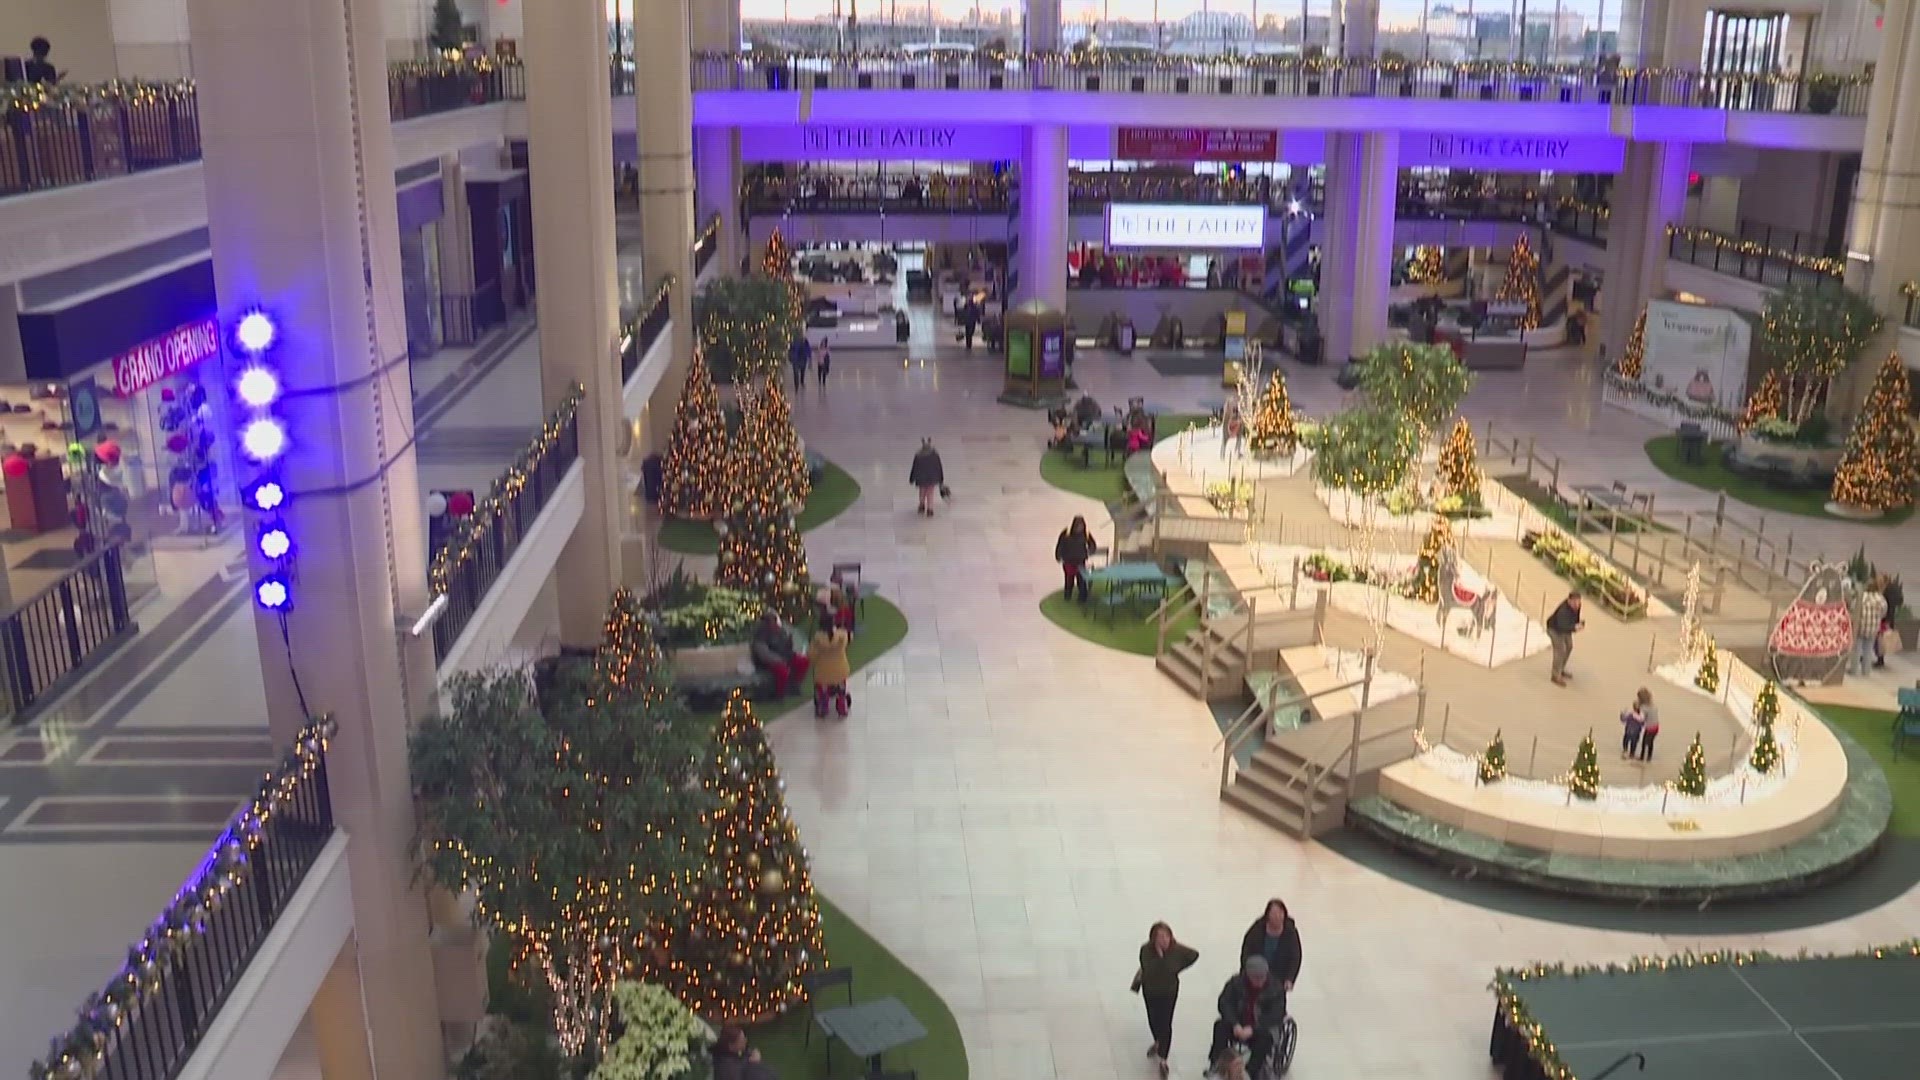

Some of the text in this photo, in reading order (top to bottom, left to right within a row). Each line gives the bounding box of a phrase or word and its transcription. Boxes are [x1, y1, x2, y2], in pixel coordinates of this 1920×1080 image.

[833, 127, 873, 147] THE
[880, 127, 956, 148] EATERY
[1457, 137, 1493, 155] THE
[1501, 137, 1569, 158] EATERY
[1145, 216, 1176, 234] THE
[1187, 216, 1257, 234] EATERY
[118, 320, 217, 395] GRAND OPENING
